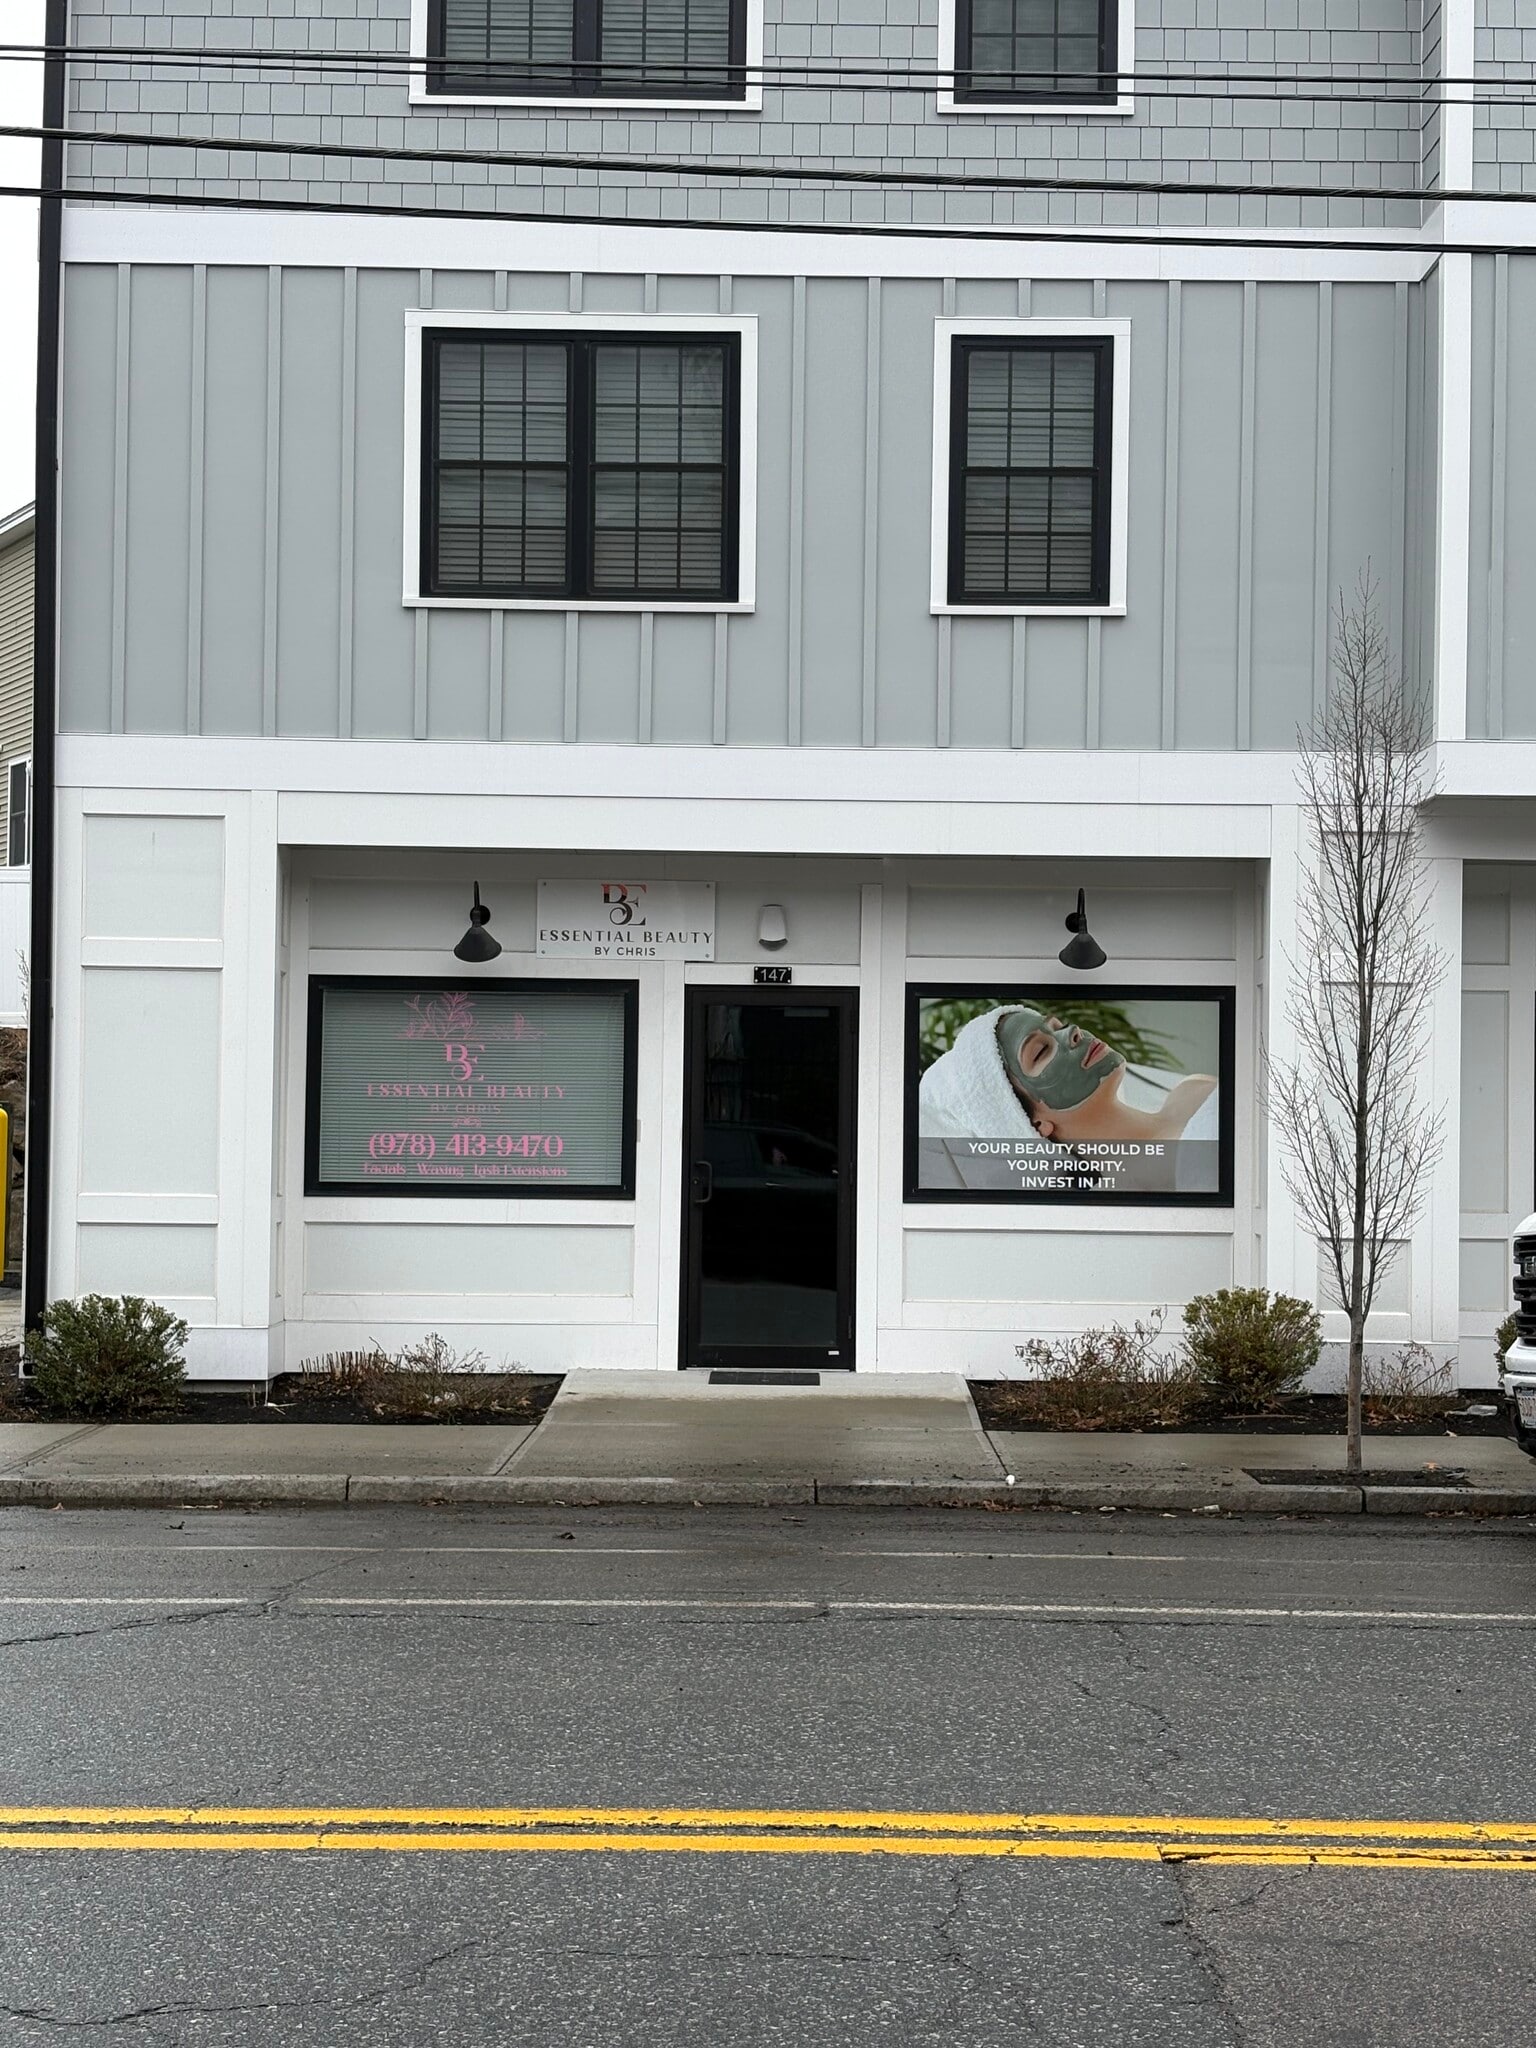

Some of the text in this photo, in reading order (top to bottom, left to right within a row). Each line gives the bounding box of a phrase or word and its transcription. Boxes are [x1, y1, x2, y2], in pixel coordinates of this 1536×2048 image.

[539, 929, 713, 945] ESSENTIAL BEAUTY
[594, 946, 656, 957] BY CHRIS
[760, 968, 787, 983] 147
[368, 1132, 564, 1160] (978) 413-9470
[968, 1142, 1165, 1156] YOUR BEAUTY SHOULD BE
[1006, 1159, 1126, 1173] YOUR PRIORITY.
[1021, 1176, 1116, 1189] INVEST IN IT!
